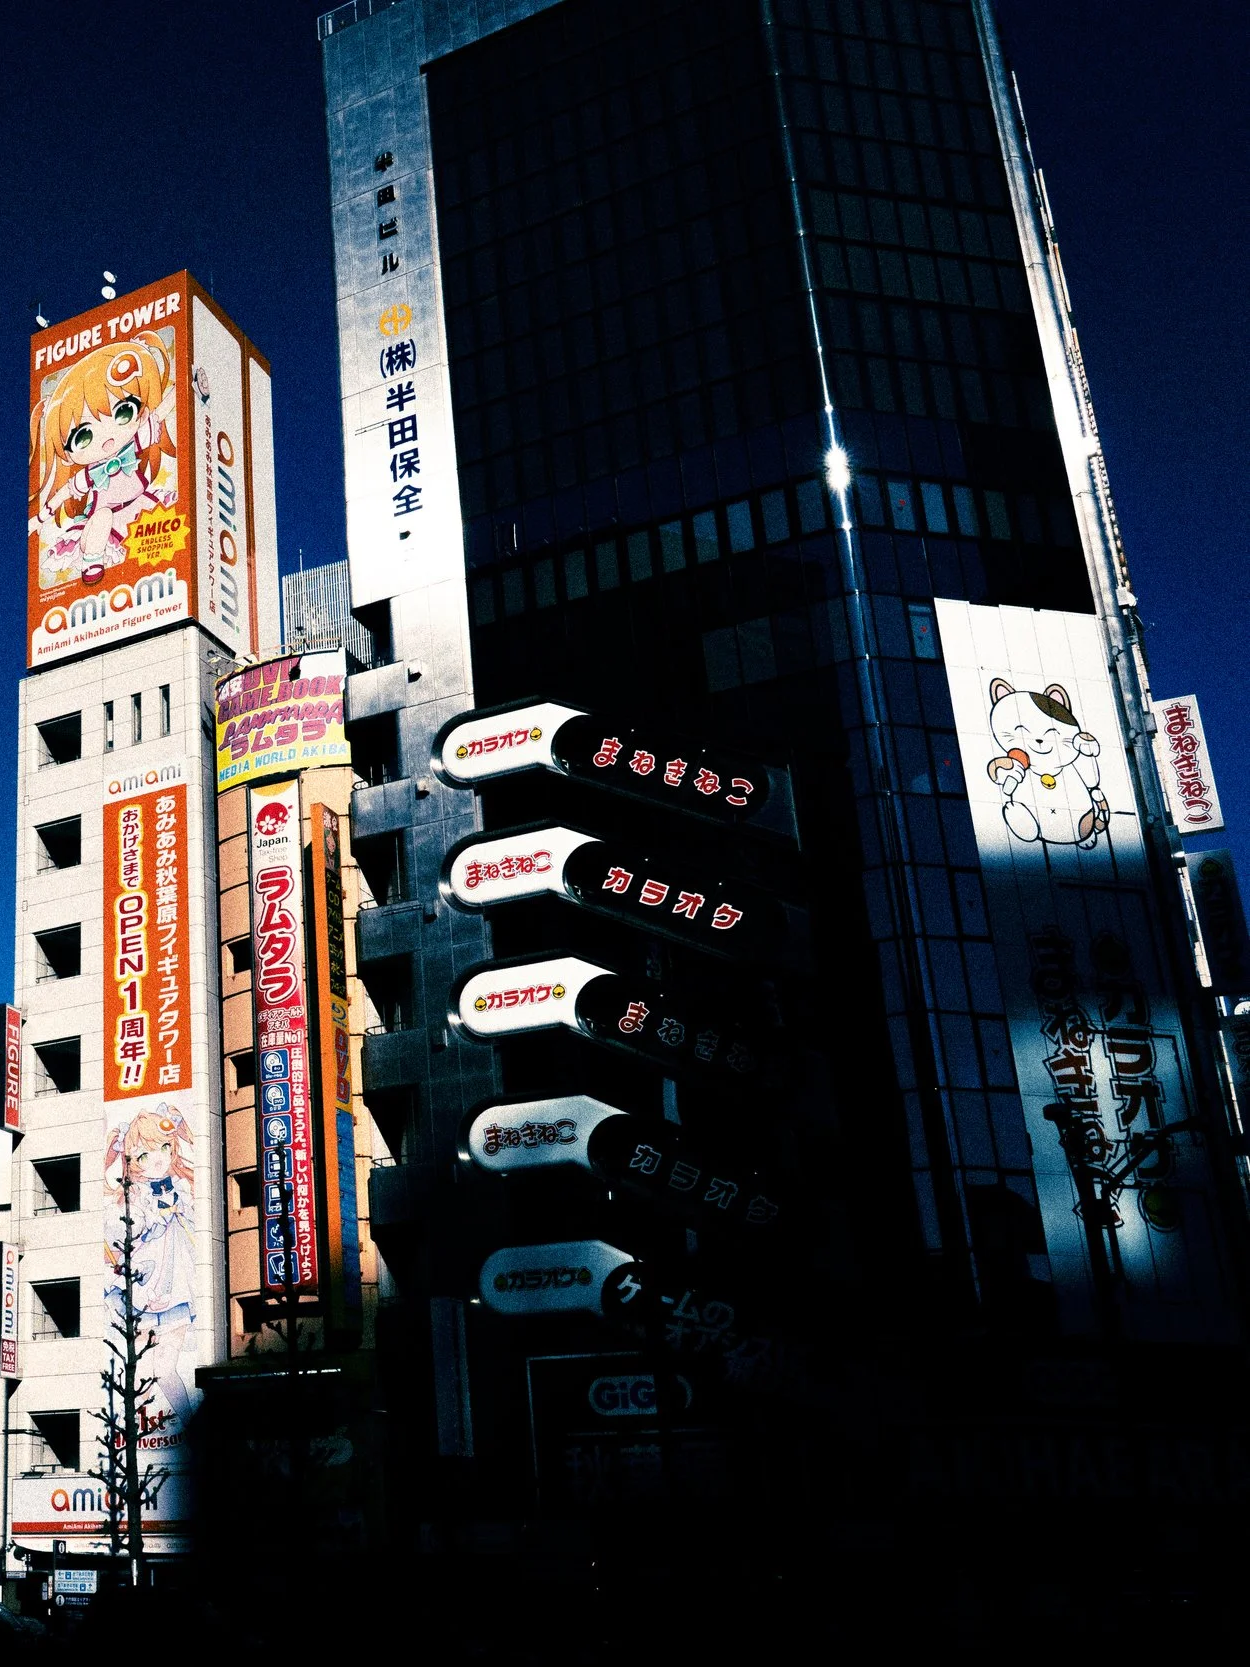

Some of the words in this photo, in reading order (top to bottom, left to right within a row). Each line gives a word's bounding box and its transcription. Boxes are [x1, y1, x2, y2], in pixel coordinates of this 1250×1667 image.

[374, 150, 399, 275] 半田ビル
[34, 323, 102, 370] FIGURE
[107, 291, 181, 337] TOWER
[380, 339, 424, 517] (株)半田保全
[134, 518, 181, 539] AMICO
[137, 541, 174, 554] SHOPPING
[140, 534, 172, 546] ENDLESS
[217, 430, 240, 634] amiami
[44, 571, 174, 634] amiami
[37, 636, 71, 656] AmiAmi
[73, 624, 120, 643] Akihabara
[122, 612, 152, 630] Figure
[154, 602, 183, 617] Tower
[467, 728, 531, 757] カラオケ
[108, 763, 182, 796] amiami
[219, 763, 250, 783] MEDIA
[255, 749, 297, 769] WORLD
[302, 743, 347, 758] AKIBA
[593, 737, 754, 806] まねきねこ
[1161, 702, 1214, 825] まねきねこ
[464, 850, 552, 890] まねきねこ
[602, 866, 743, 930] カラオケ
[154, 794, 181, 1086] あみあみ秋葉原フィギュアタワー店
[257, 867, 297, 1002] ラムタラ
[257, 1005, 304, 1024] メディアワールド
[486, 984, 554, 1010] カラオケ
[267, 1019, 290, 1031] アキバ
[7, 1023, 21, 1111] FIGURE
[483, 1118, 579, 1157] まねきねこ
[630, 1143, 779, 1225] カラオケ
[4, 1250, 17, 1335] amiami
[2, 1353, 16, 1362] TAX
[2, 1362, 16, 1373] FREE
[137, 1404, 166, 1432] 1st
[51, 1487, 158, 1512] amiai
[62, 1522, 84, 1530] AmiAmi
